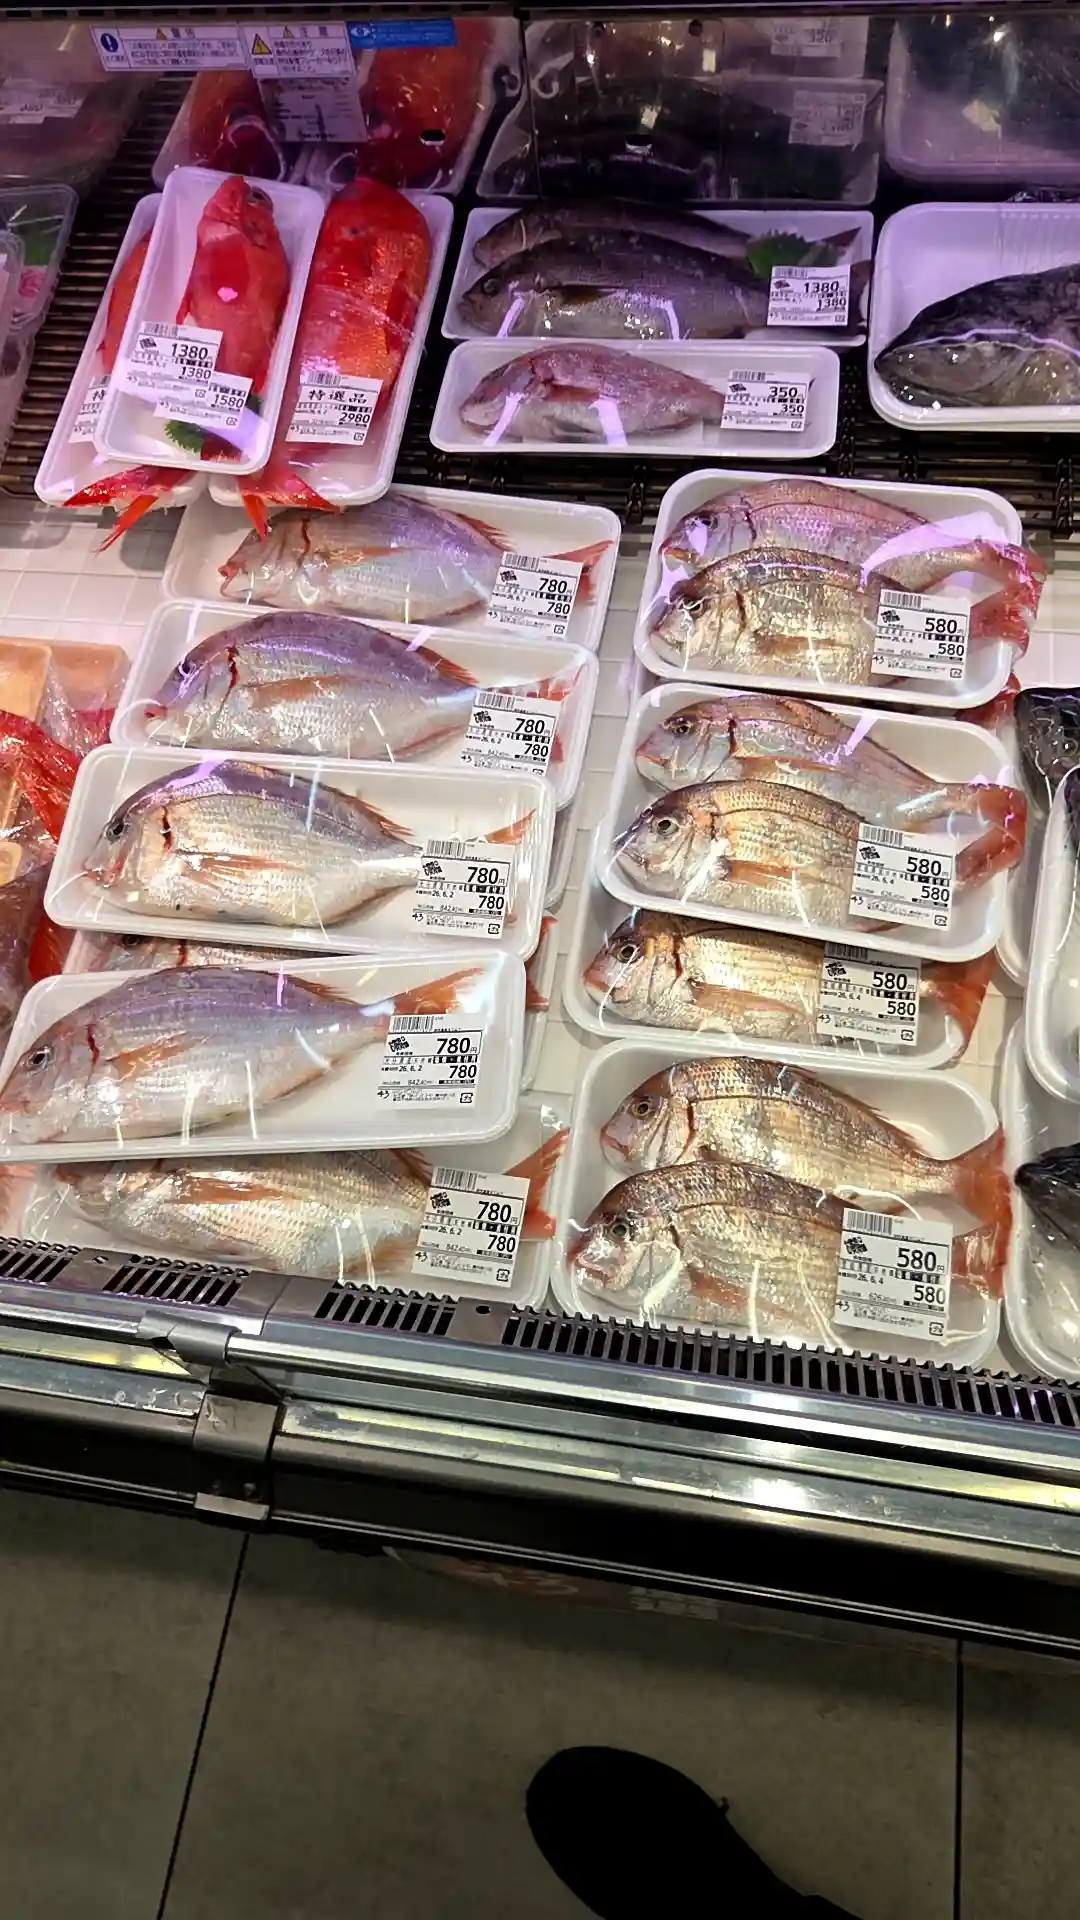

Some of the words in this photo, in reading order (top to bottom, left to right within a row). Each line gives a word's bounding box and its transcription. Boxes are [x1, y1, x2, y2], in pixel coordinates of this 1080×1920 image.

[817, 298, 846, 311] 1380
[180, 366, 212, 380] 1380
[214, 394, 244, 409] 1580
[781, 404, 805, 414] 350
[339, 412, 371, 424] 2980
[546, 601, 571, 615] 780
[938, 643, 965, 657] 580
[524, 743, 549, 758] 780
[921, 885, 950, 902] 580
[478, 895, 505, 910] 780
[887, 1001, 916, 1016] 580
[449, 1064, 478, 1079] 780
[487, 1234, 516, 1253] 780
[913, 1284, 946, 1305] 580
